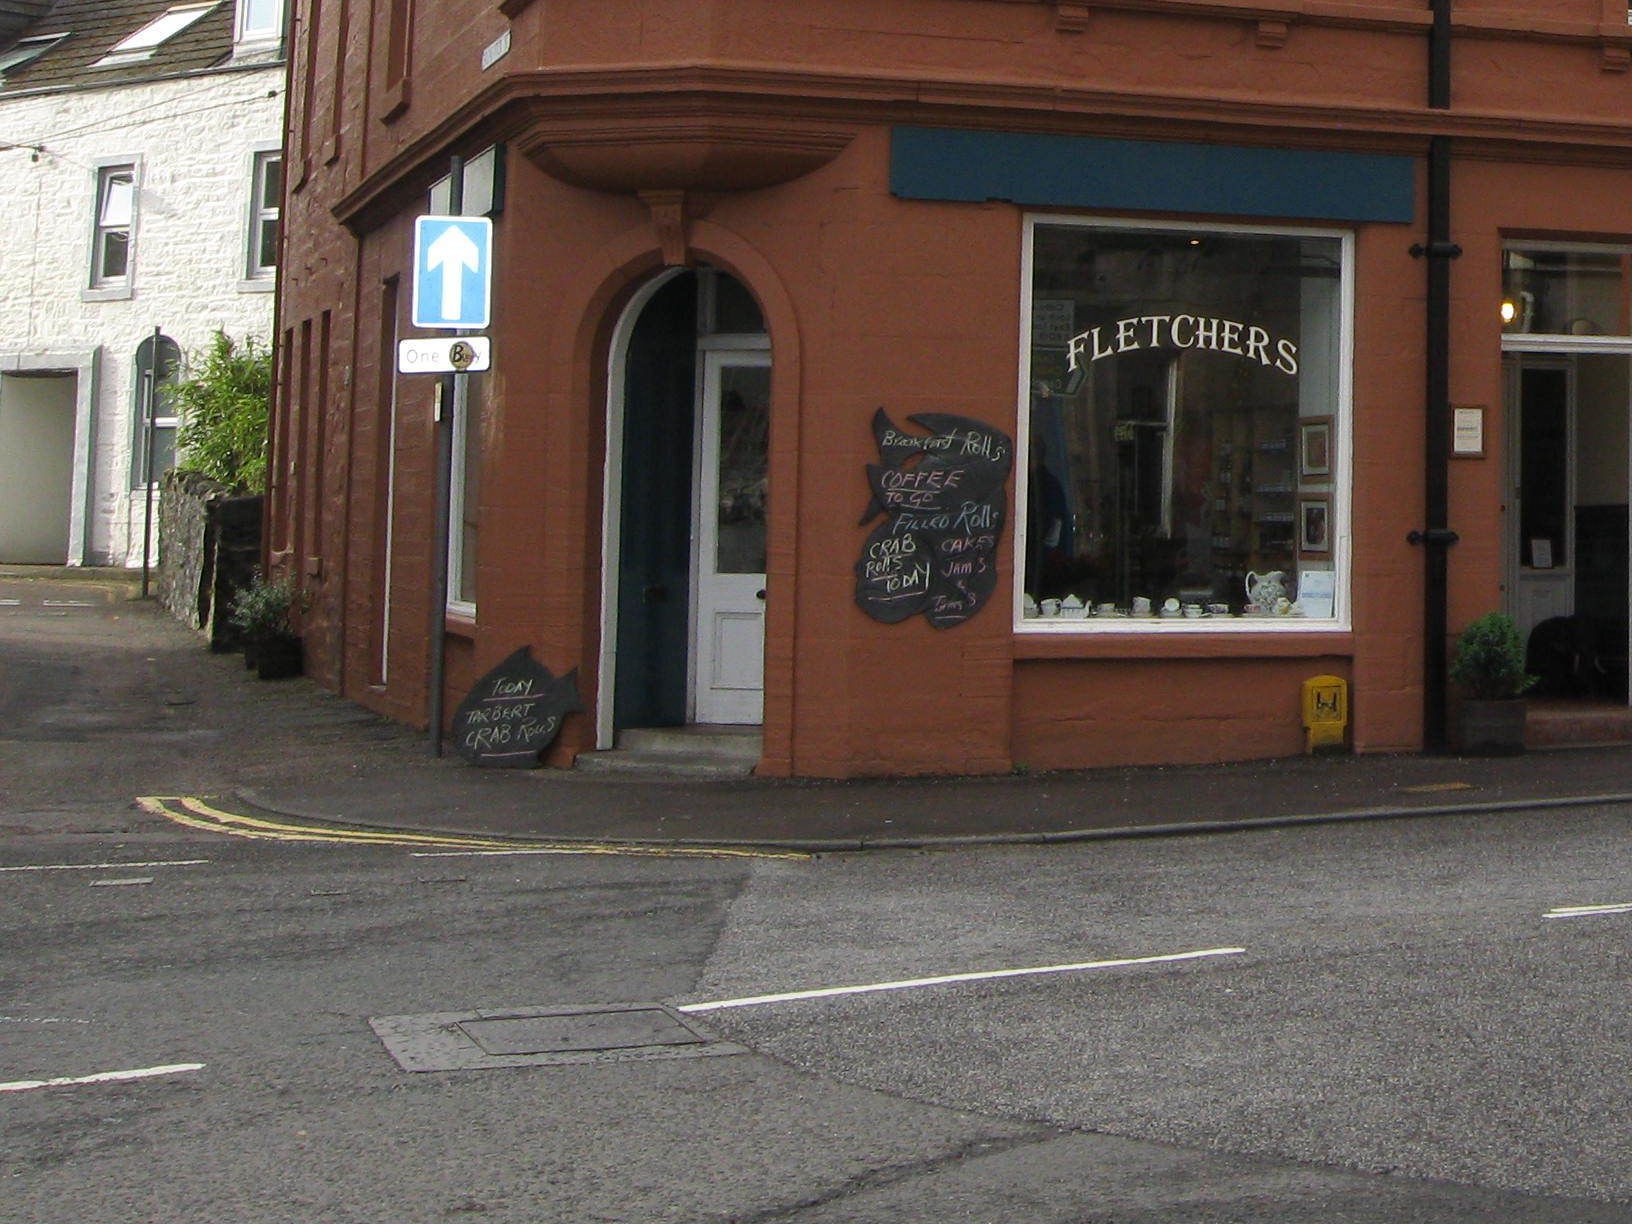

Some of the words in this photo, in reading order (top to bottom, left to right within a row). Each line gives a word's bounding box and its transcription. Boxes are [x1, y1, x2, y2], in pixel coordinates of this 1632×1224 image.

[1066, 314, 1299, 376] FLETCHERS
[407, 349, 439, 364] One
[881, 470, 964, 489] COFFEE
[886, 491, 904, 503] TO
[909, 492, 934, 507] GO
[869, 533, 916, 559] CRAB
[941, 535, 994, 554] CAKES
[885, 562, 930, 594] TODAY
[492, 677, 534, 696] TODAY
[465, 702, 536, 725] TARBERT
[465, 723, 513, 751] CRAB
